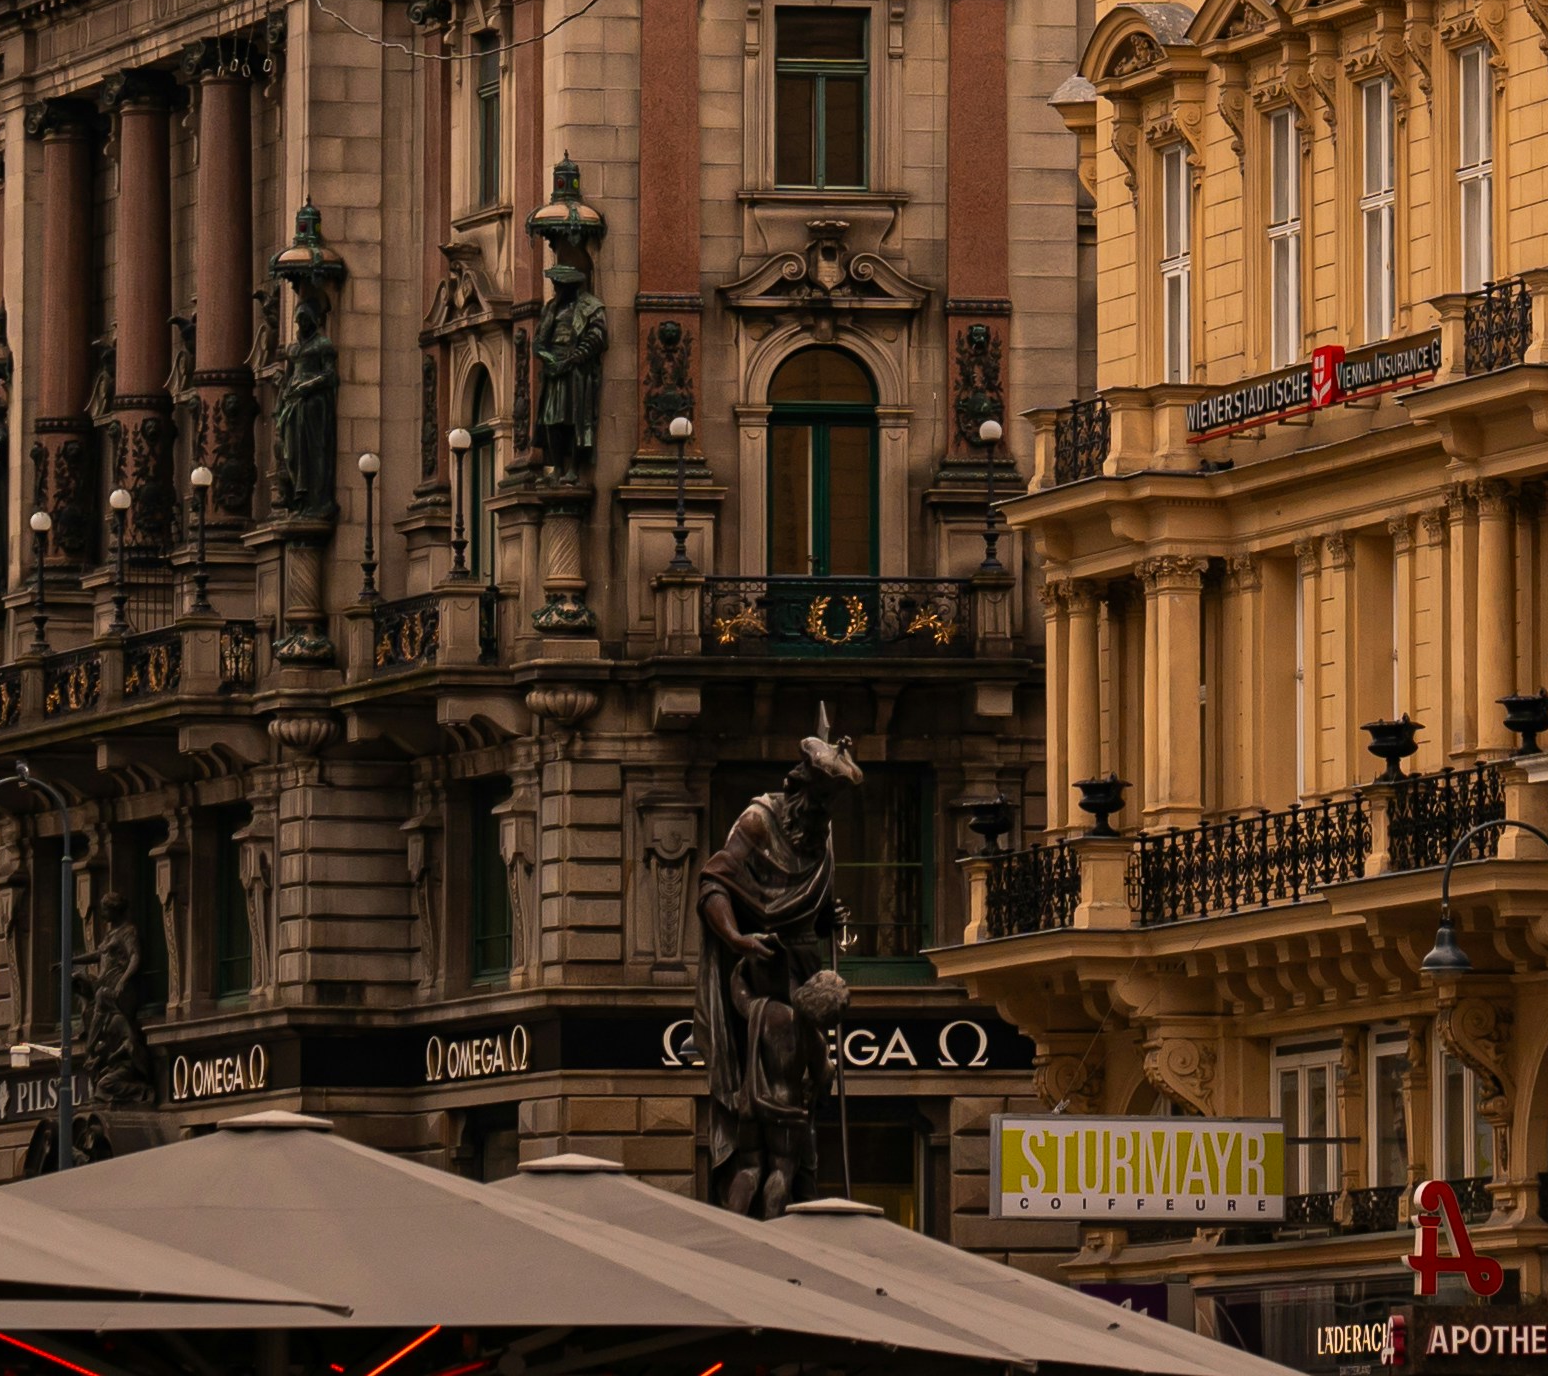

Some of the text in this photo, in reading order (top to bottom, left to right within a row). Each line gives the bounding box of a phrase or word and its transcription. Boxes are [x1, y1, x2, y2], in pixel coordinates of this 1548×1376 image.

[1185, 394, 1233, 433] WIENER
[1235, 371, 1309, 419] STÄDTISCHE
[1336, 361, 1373, 391] VIENNA
[1374, 348, 1429, 378] INSURANCE
[192, 1053, 244, 1096] OMEGA
[447, 1034, 505, 1079] OMEGA
[16, 1075, 82, 1113] PILSL
[1021, 1128, 1266, 1196] STURMAYR
[1020, 1197, 1266, 1211] COIFFEURE
